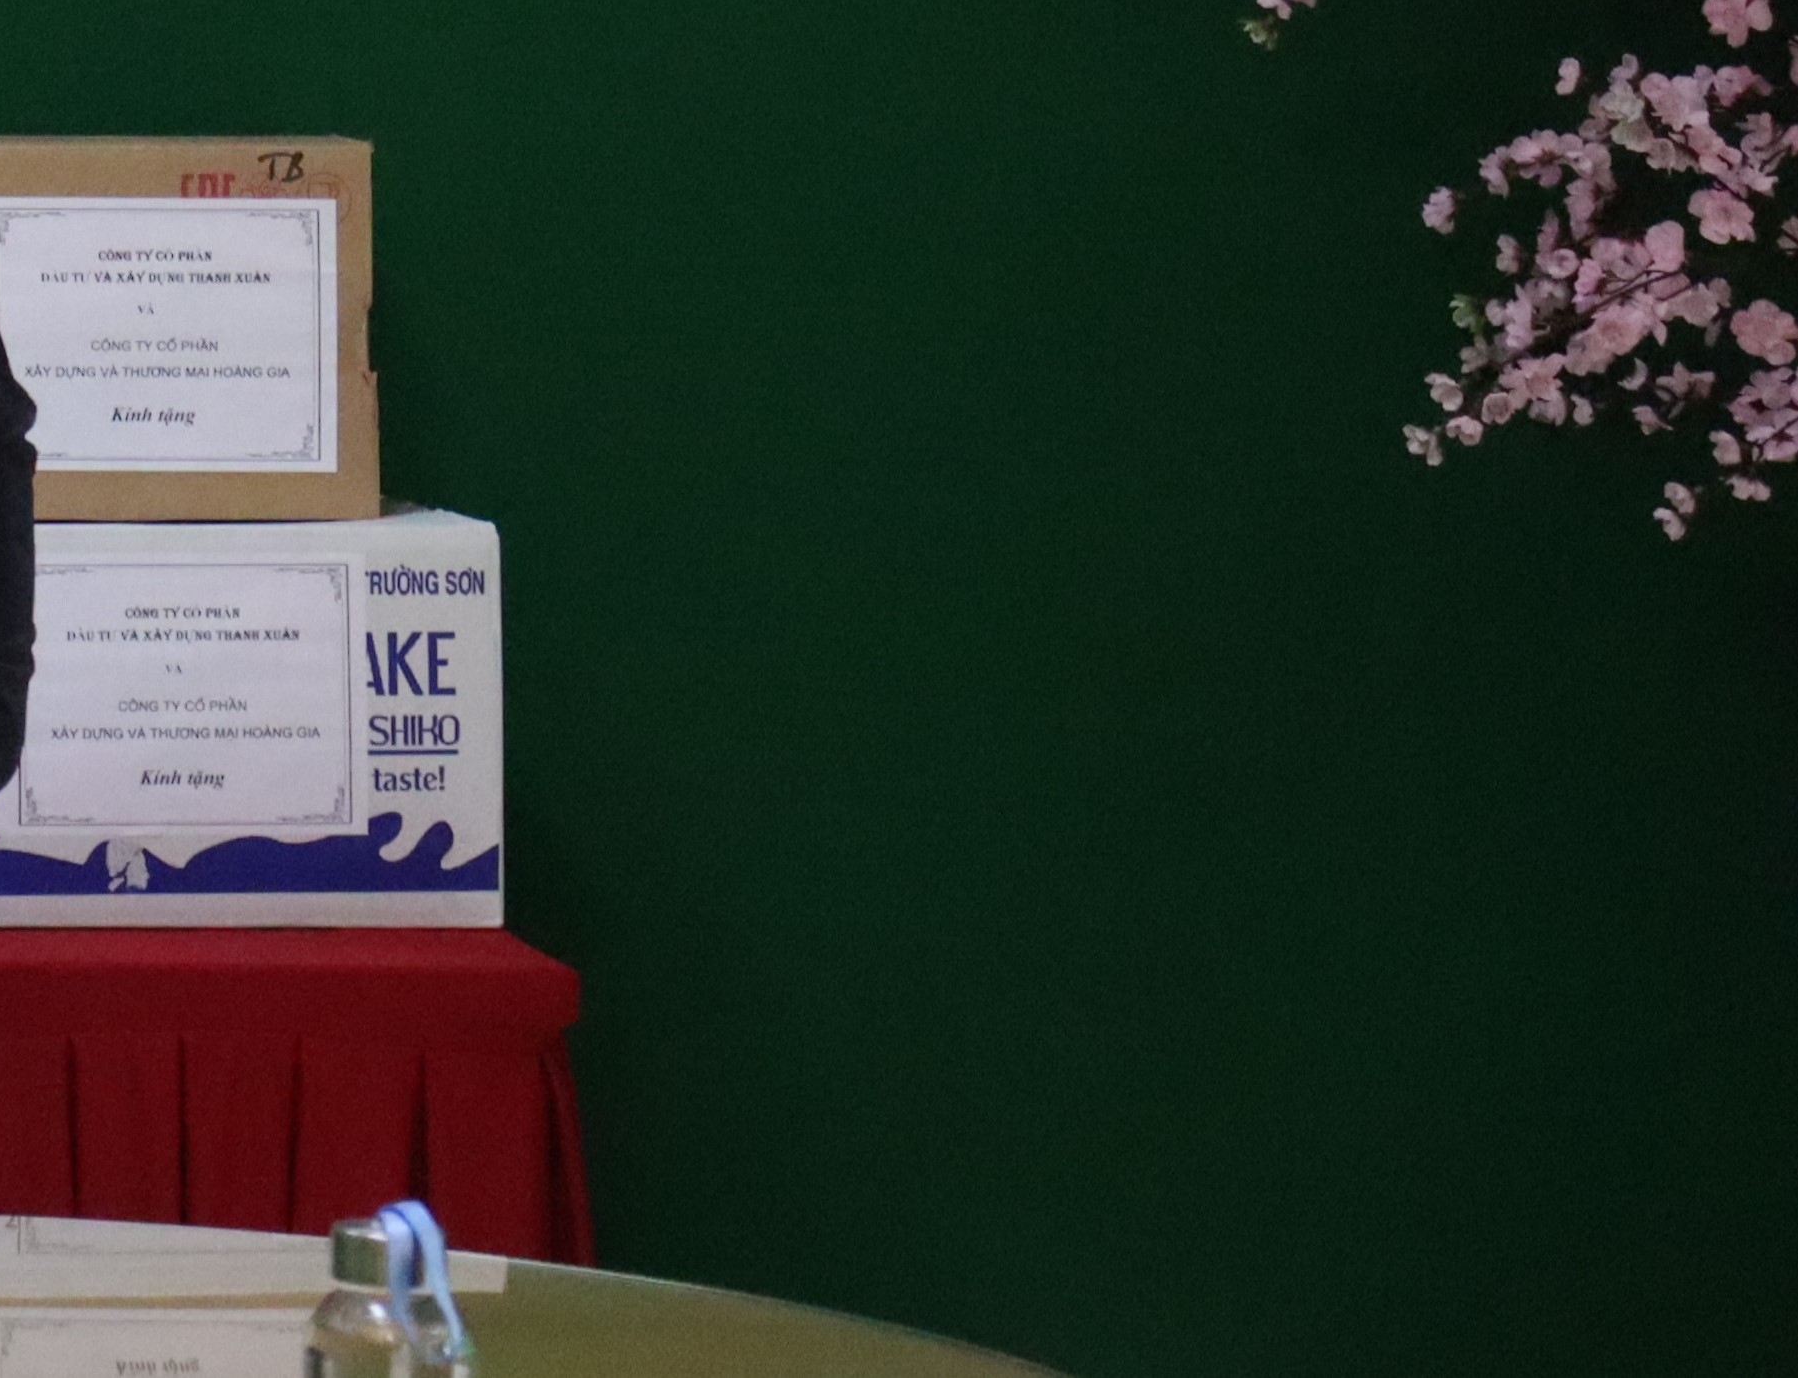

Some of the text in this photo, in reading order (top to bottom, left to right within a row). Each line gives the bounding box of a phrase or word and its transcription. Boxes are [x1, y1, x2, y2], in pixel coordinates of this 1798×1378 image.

[98, 248, 132, 262] CÔNG
[135, 249, 154, 262] TY
[188, 272, 231, 284] THANH
[235, 270, 271, 284] XUÂN
[90, 337, 132, 352] CÔNG
[135, 340, 153, 352] TY
[99, 364, 118, 378] VÀ
[122, 365, 181, 378] THƯƠNG
[213, 364, 263, 378] HOÀNG
[267, 366, 291, 378] GIA
[445, 567, 486, 595] SƠN
[124, 605, 159, 619] CÔNG
[162, 606, 181, 619] TY
[216, 630, 260, 641] THANH
[263, 627, 300, 641] XUÂN
[118, 698, 159, 712] CÔNG
[164, 700, 181, 712] TY
[127, 725, 146, 740] VÀ
[150, 727, 210, 740] THƯƠNG
[243, 725, 293, 740] HOÀNG
[297, 726, 321, 739] GIA
[140, 770, 225, 789] Kính tặng
[373, 765, 446, 792] taste!
